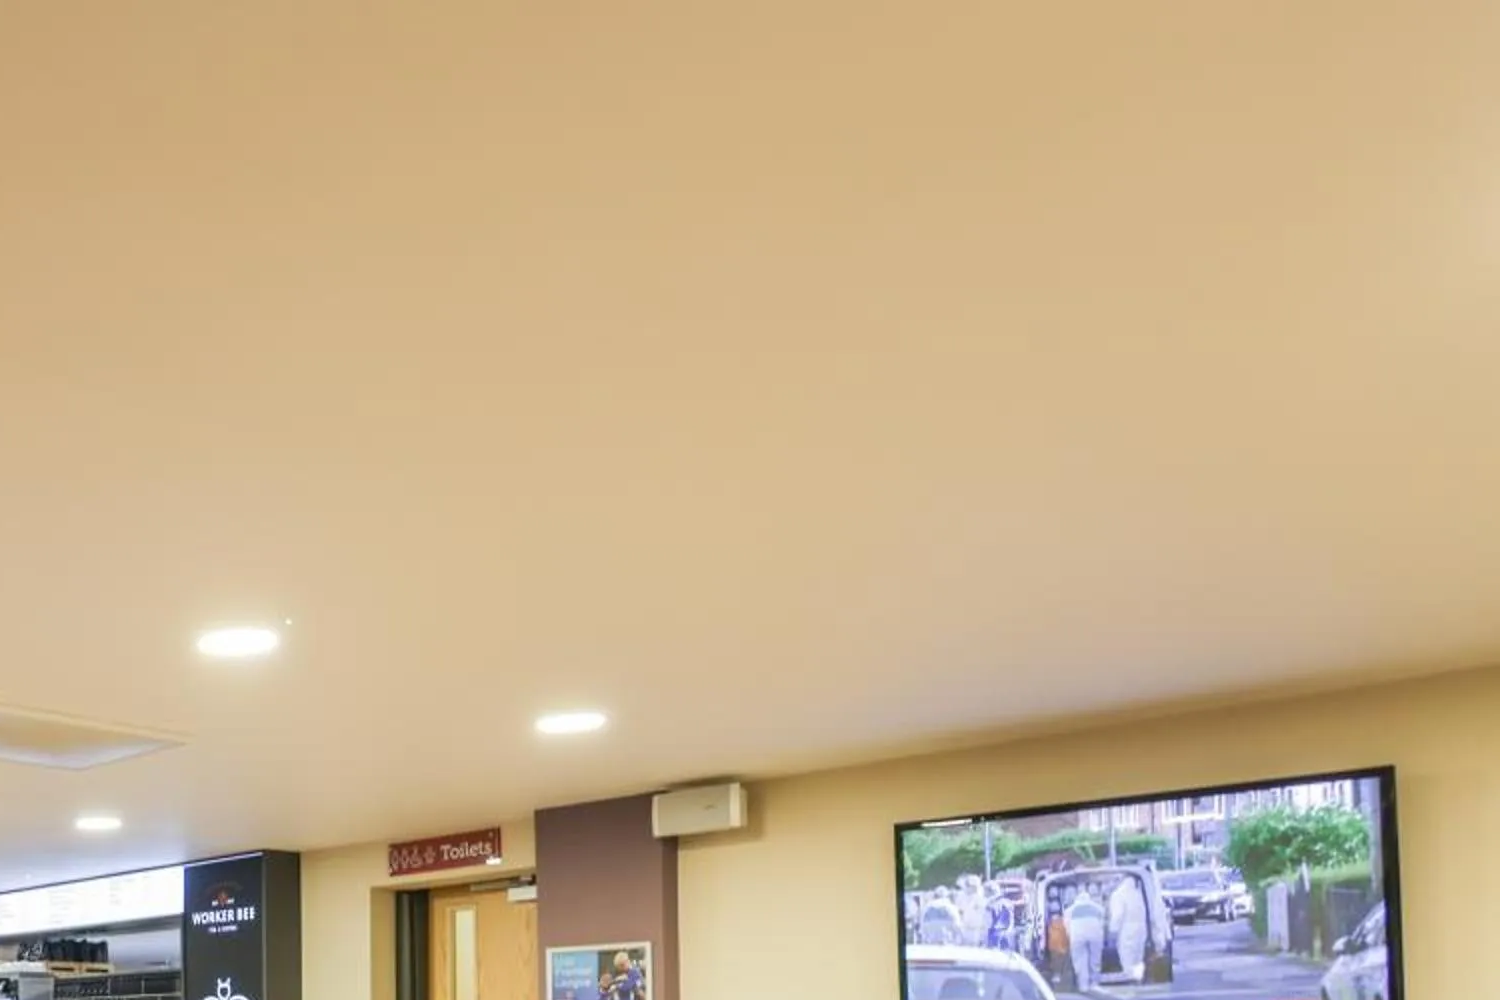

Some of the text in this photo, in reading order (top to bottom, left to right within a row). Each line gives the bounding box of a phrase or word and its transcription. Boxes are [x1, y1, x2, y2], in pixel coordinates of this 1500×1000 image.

[440, 841, 493, 861] Toilets
[191, 906, 256, 925] WORKER BEE
